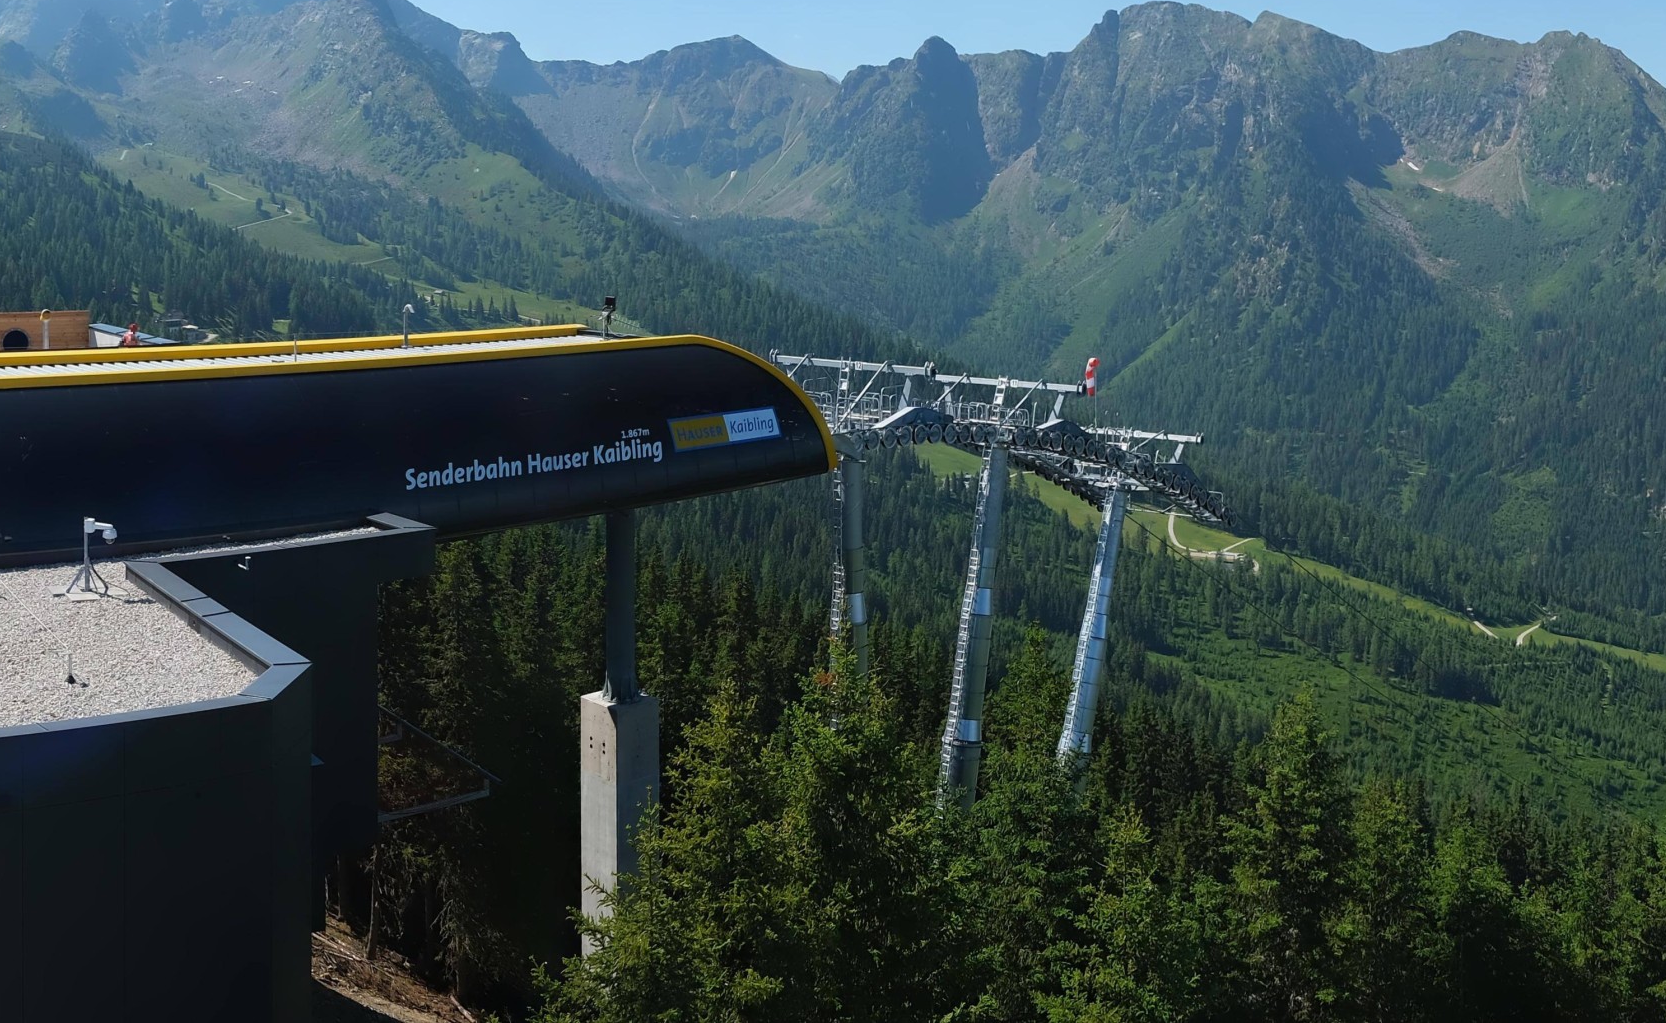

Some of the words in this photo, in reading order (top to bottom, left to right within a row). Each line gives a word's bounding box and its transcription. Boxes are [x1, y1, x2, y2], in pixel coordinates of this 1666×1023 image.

[621, 428, 650, 438] 1.867m
[677, 425, 724, 441] HAUSER
[729, 417, 774, 434] Kaibling
[405, 456, 522, 490] Senderbahn
[527, 450, 590, 475] Hauser
[593, 438, 663, 465] Kaibling
